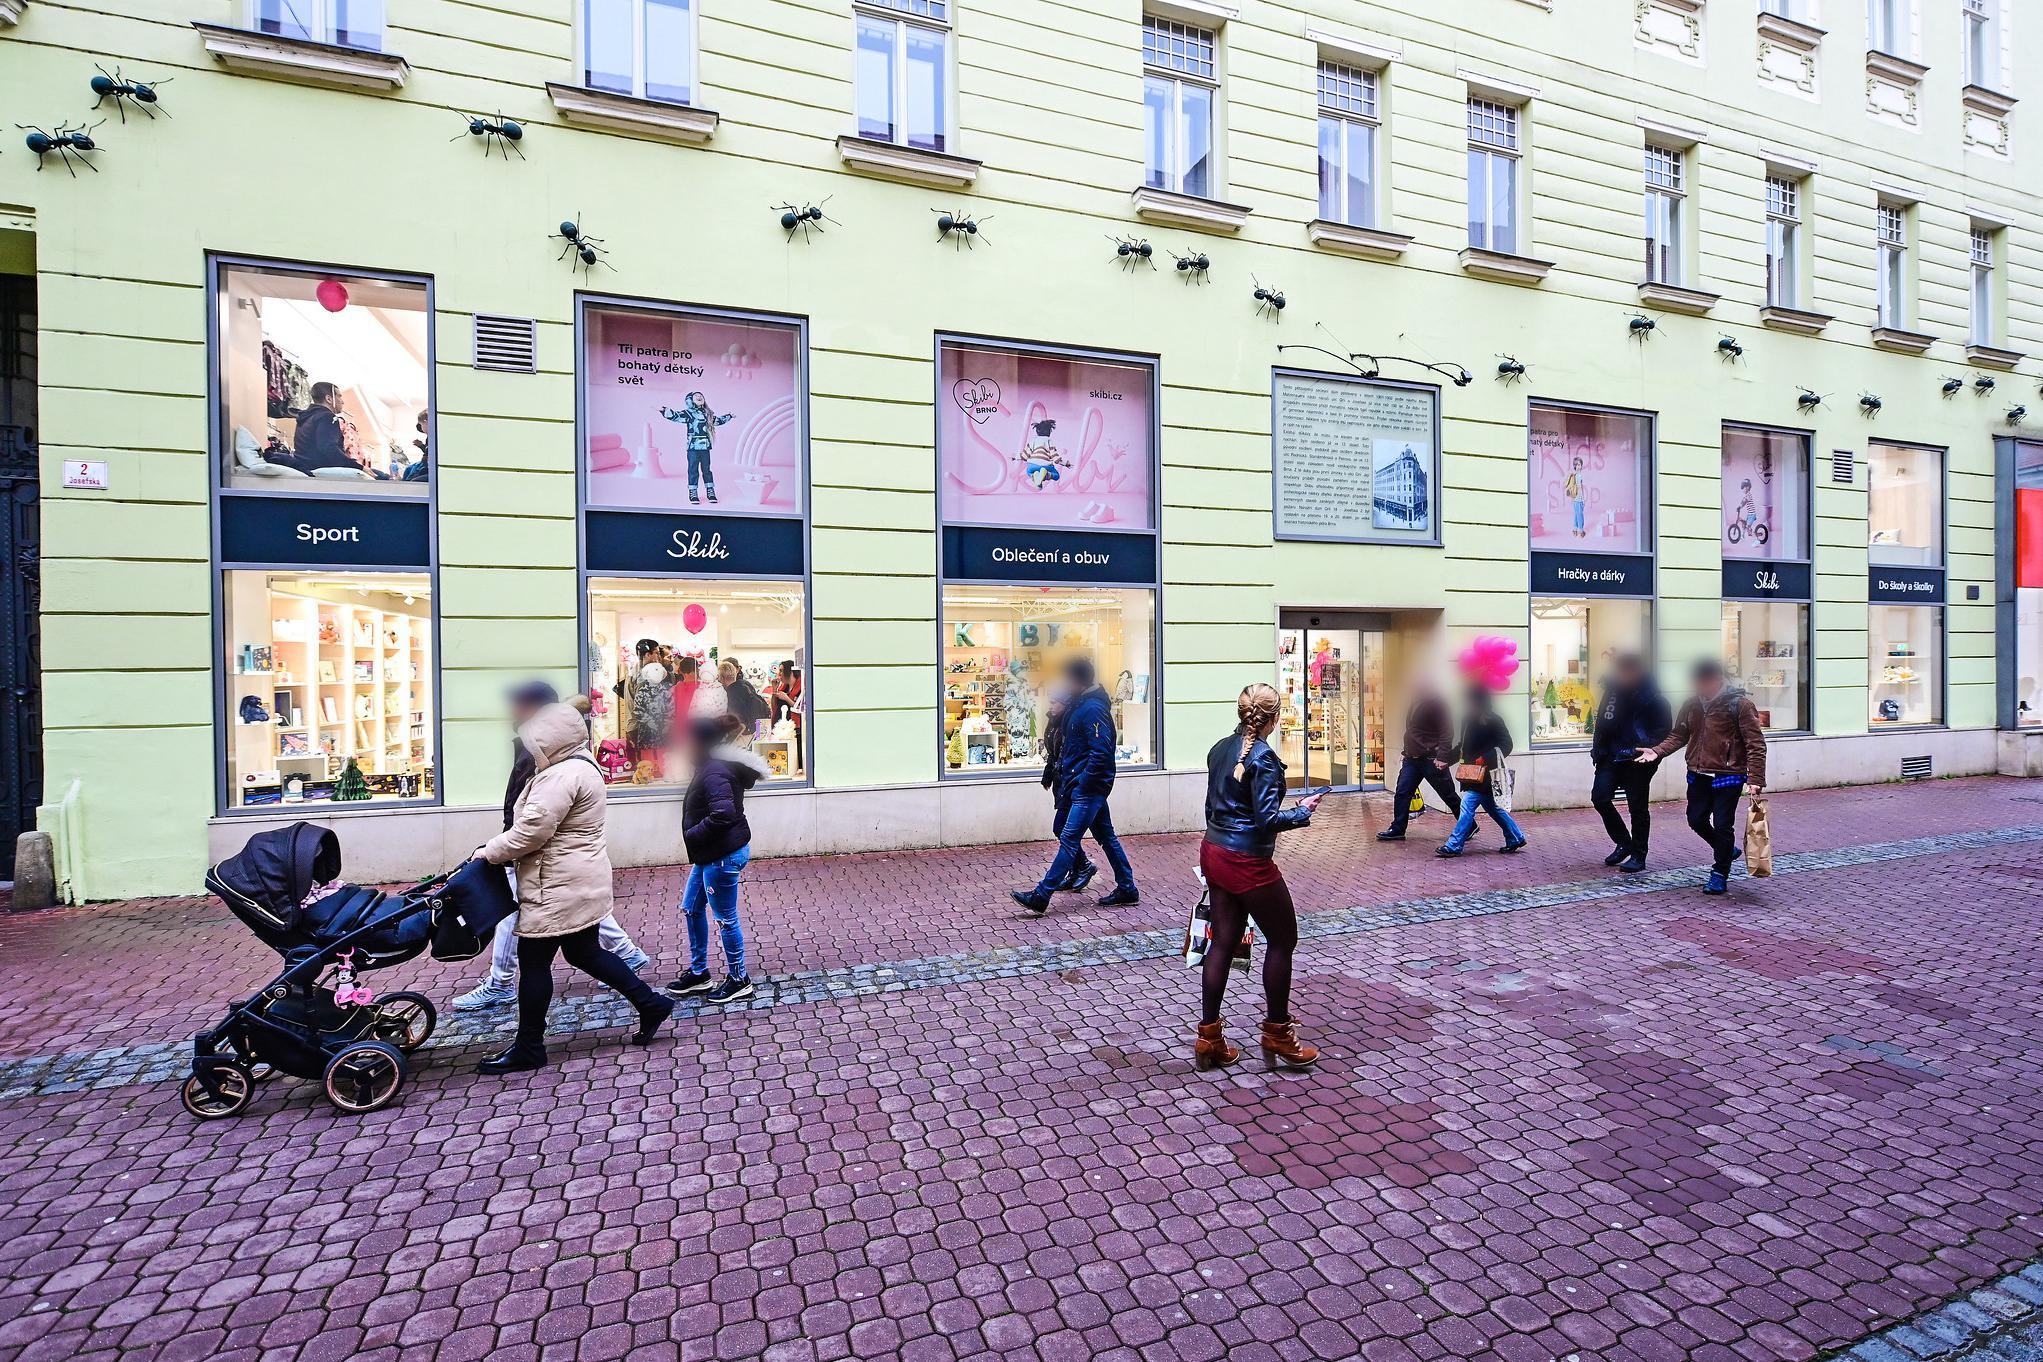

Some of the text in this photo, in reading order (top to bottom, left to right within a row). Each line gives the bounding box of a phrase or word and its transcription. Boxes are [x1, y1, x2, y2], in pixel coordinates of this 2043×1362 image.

[618, 343, 693, 360] Tři patra pro
[618, 359, 704, 378] bohatý dětský
[618, 375, 644, 386] svět
[962, 384, 994, 409] Skibi
[1089, 389, 1123, 401] skibi.cz
[975, 406, 998, 414] BRNO
[80, 463, 88, 475] 2
[296, 523, 360, 545] Sport
[666, 529, 730, 559] Skibi
[991, 547, 1110, 564] Oblečení a obuv
[1558, 567, 1626, 584] Hračky a dárky
[1753, 571, 1780, 590] Skibi
[1878, 580, 1935, 594] Do školy a školky
